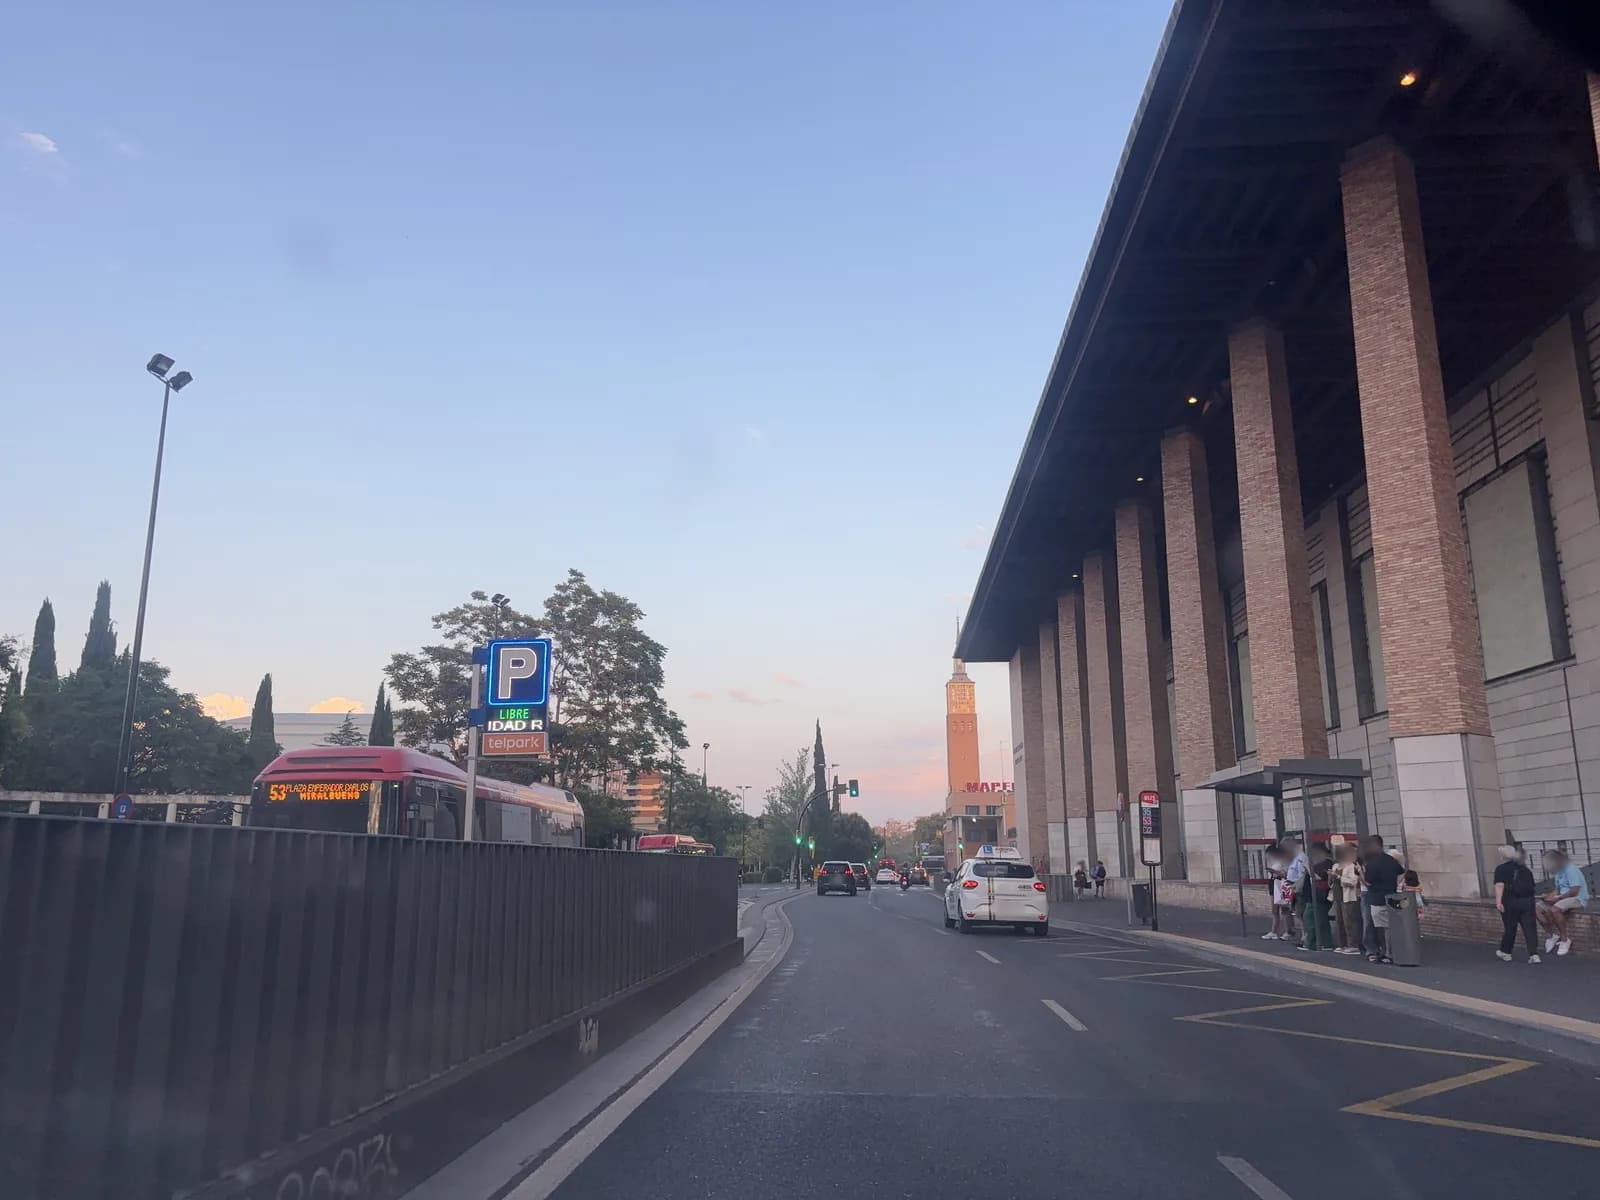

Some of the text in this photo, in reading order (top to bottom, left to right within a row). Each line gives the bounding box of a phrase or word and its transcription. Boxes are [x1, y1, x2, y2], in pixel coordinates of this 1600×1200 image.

[498, 647, 538, 699] P
[500, 708, 529, 719] LIBRE
[487, 720, 527, 732] IDAD
[489, 736, 540, 751] telpark
[269, 784, 286, 800] 53
[286, 784, 307, 792] PLAZA
[344, 783, 369, 792] CARLOS
[299, 792, 360, 800] MIRALBUENO
